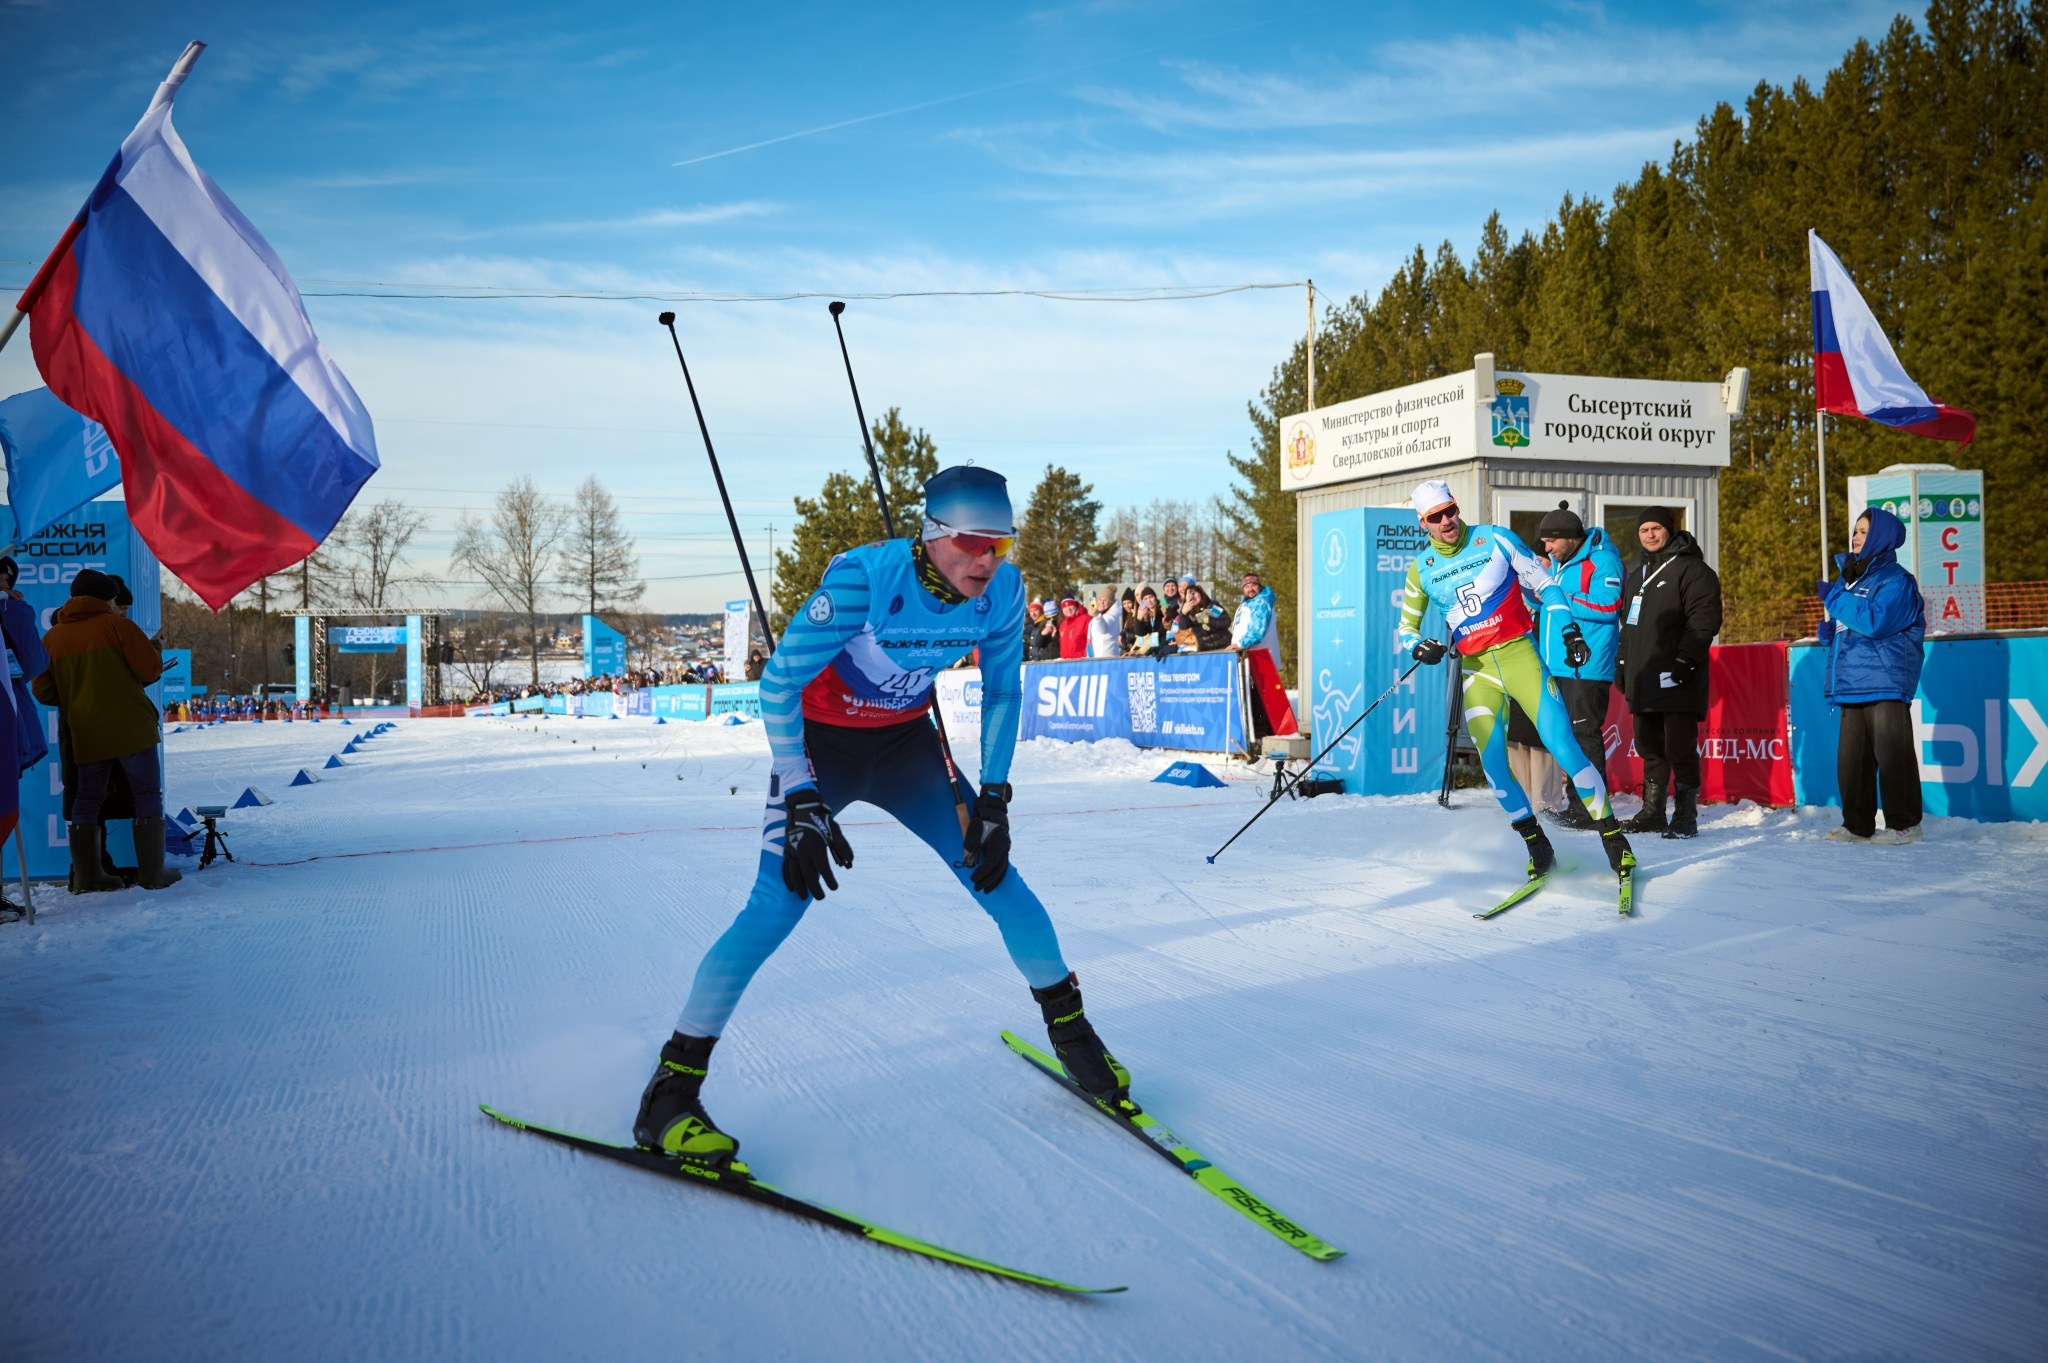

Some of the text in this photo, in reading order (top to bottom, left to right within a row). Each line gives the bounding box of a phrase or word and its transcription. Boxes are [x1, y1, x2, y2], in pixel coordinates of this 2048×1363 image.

[1322, 385, 1464, 432] Министерство физической
[1567, 393, 1692, 420] Сысертский
[1341, 416, 1440, 450] культуры и спорта
[1544, 422, 1716, 449] городской округ
[1332, 435, 1451, 469] Свердловской области
[1455, 581, 1482, 617] 5
[1469, 614, 1503, 632] ПОБЕДА!
[876, 639, 928, 649] ЛЫЖНЯ
[1159, 672, 1200, 684] Наш телеграм
[680, 1164, 720, 1181] FISCHER
[1221, 1187, 1308, 1240] FISCHER
